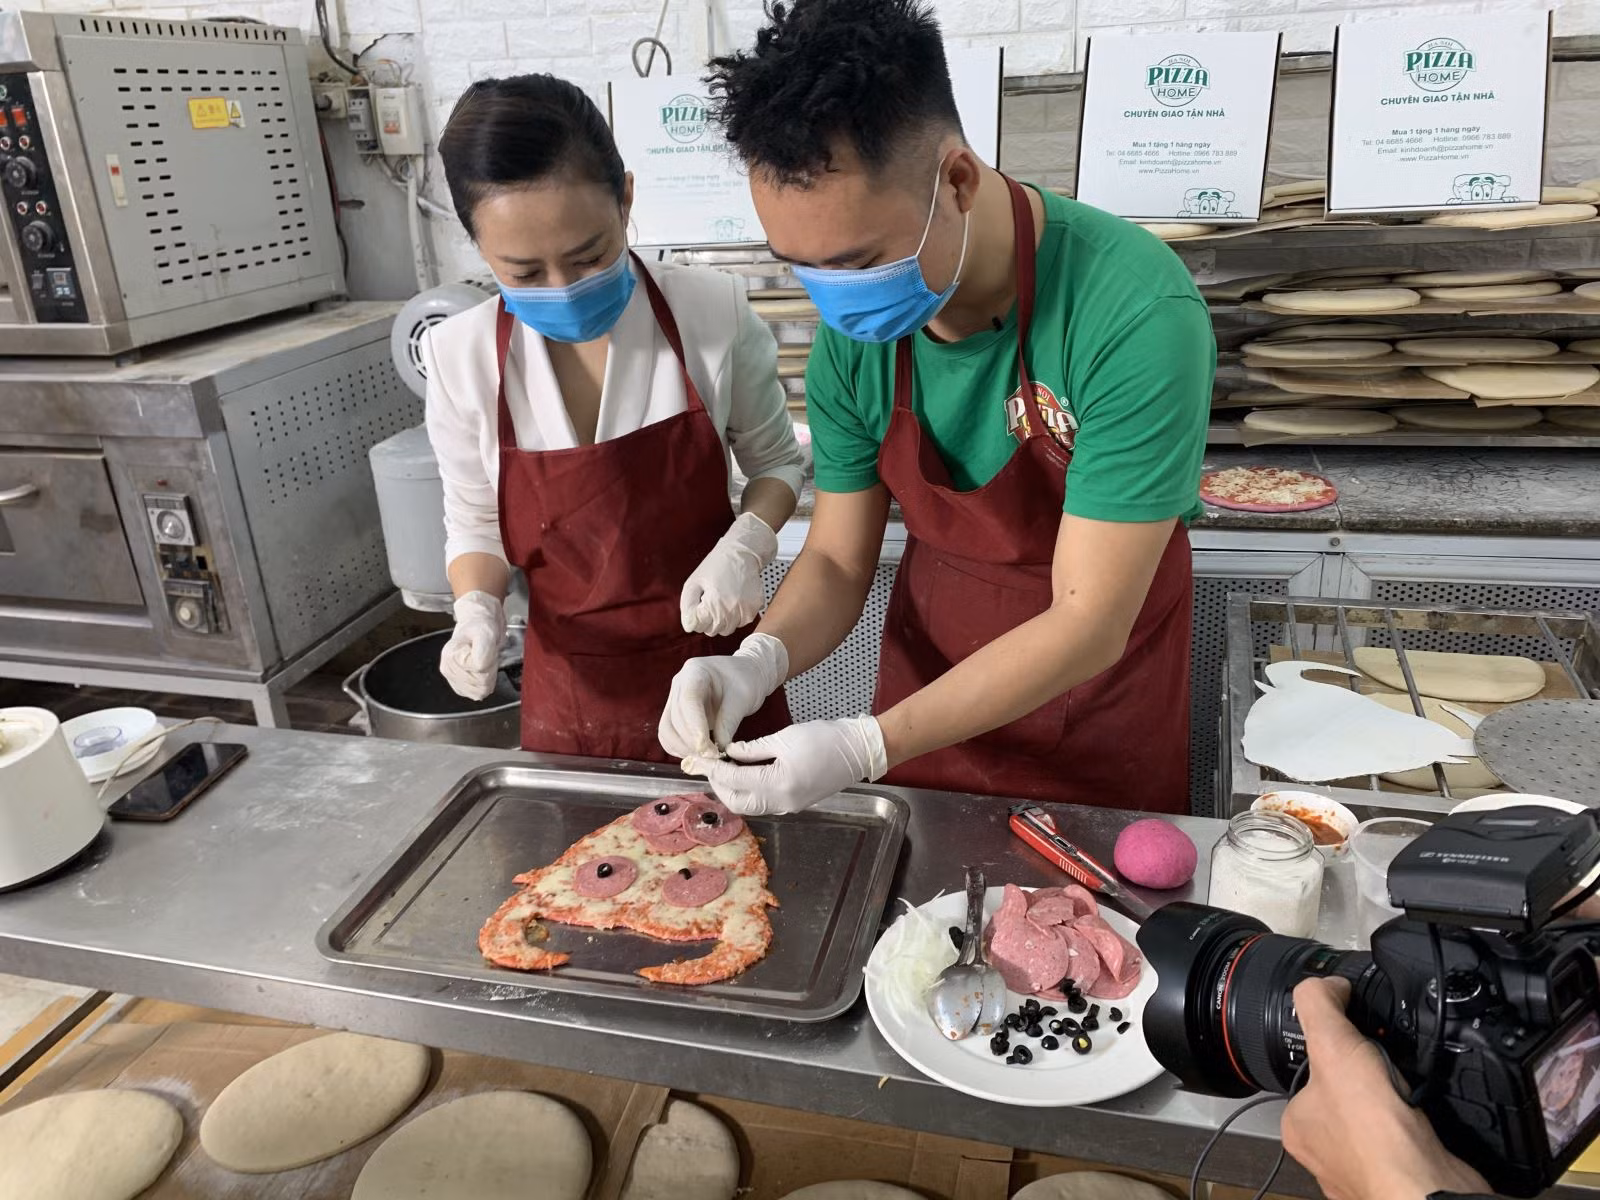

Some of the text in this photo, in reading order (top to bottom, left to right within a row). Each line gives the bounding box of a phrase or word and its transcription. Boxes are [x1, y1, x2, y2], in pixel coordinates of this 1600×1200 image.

[1406, 51, 1474, 72] PIZZA
[1147, 67, 1208, 87] PIZZA
[1417, 70, 1461, 82] HOME
[1157, 87, 1196, 97] HOME
[1422, 94, 1449, 103] GIAO
[1160, 110, 1184, 118] GIAO
[671, 125, 703, 135] HOME
[1215, 983, 1224, 1010] CANON
